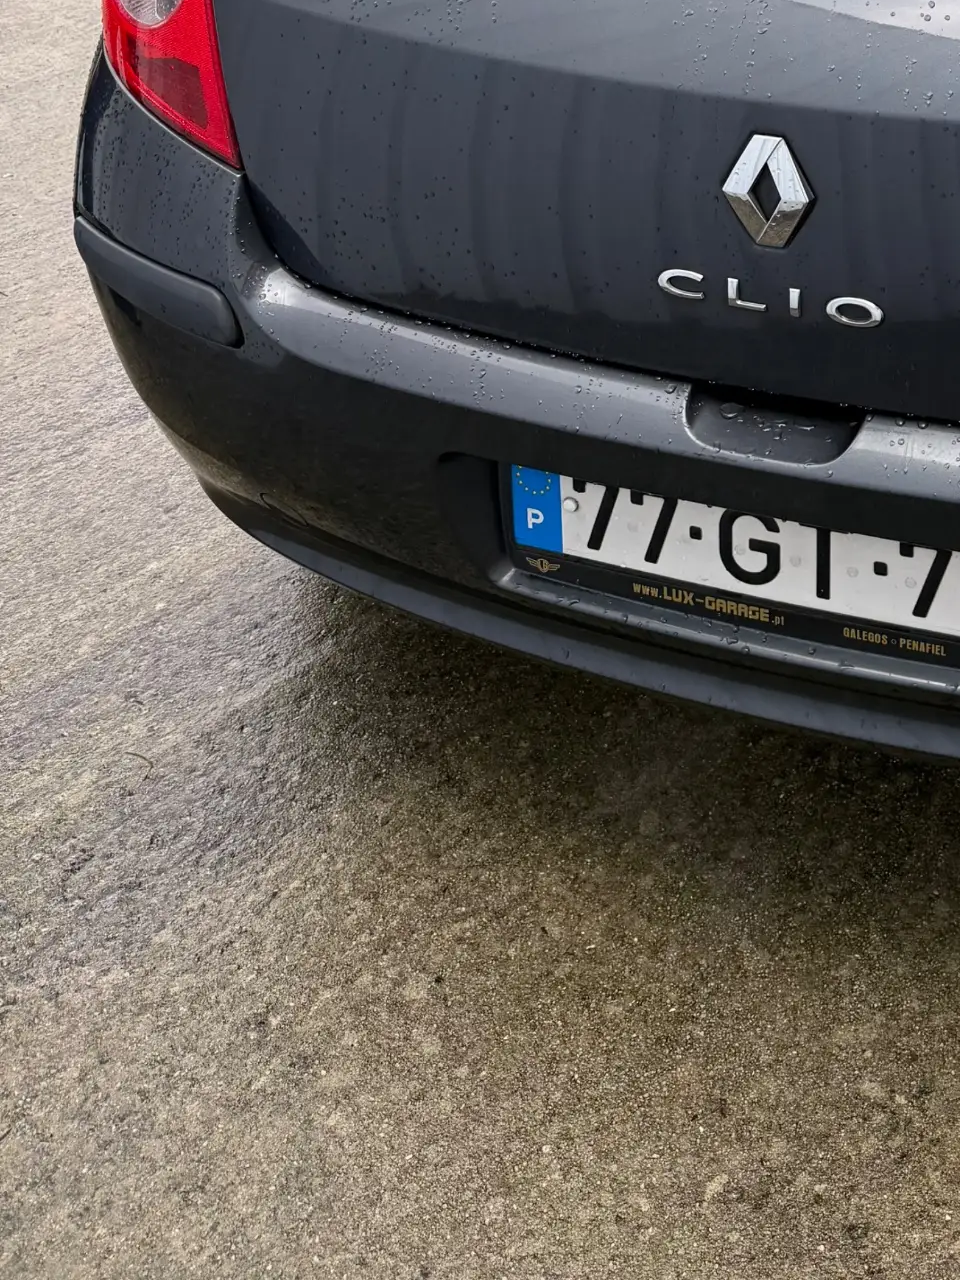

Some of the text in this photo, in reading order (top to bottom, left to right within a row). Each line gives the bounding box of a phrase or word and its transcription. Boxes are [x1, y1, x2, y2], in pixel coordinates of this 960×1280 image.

[657, 268, 884, 328] CLIO
[526, 507, 545, 530] P
[843, 626, 947, 657] GALEGOS PENAFIEL
